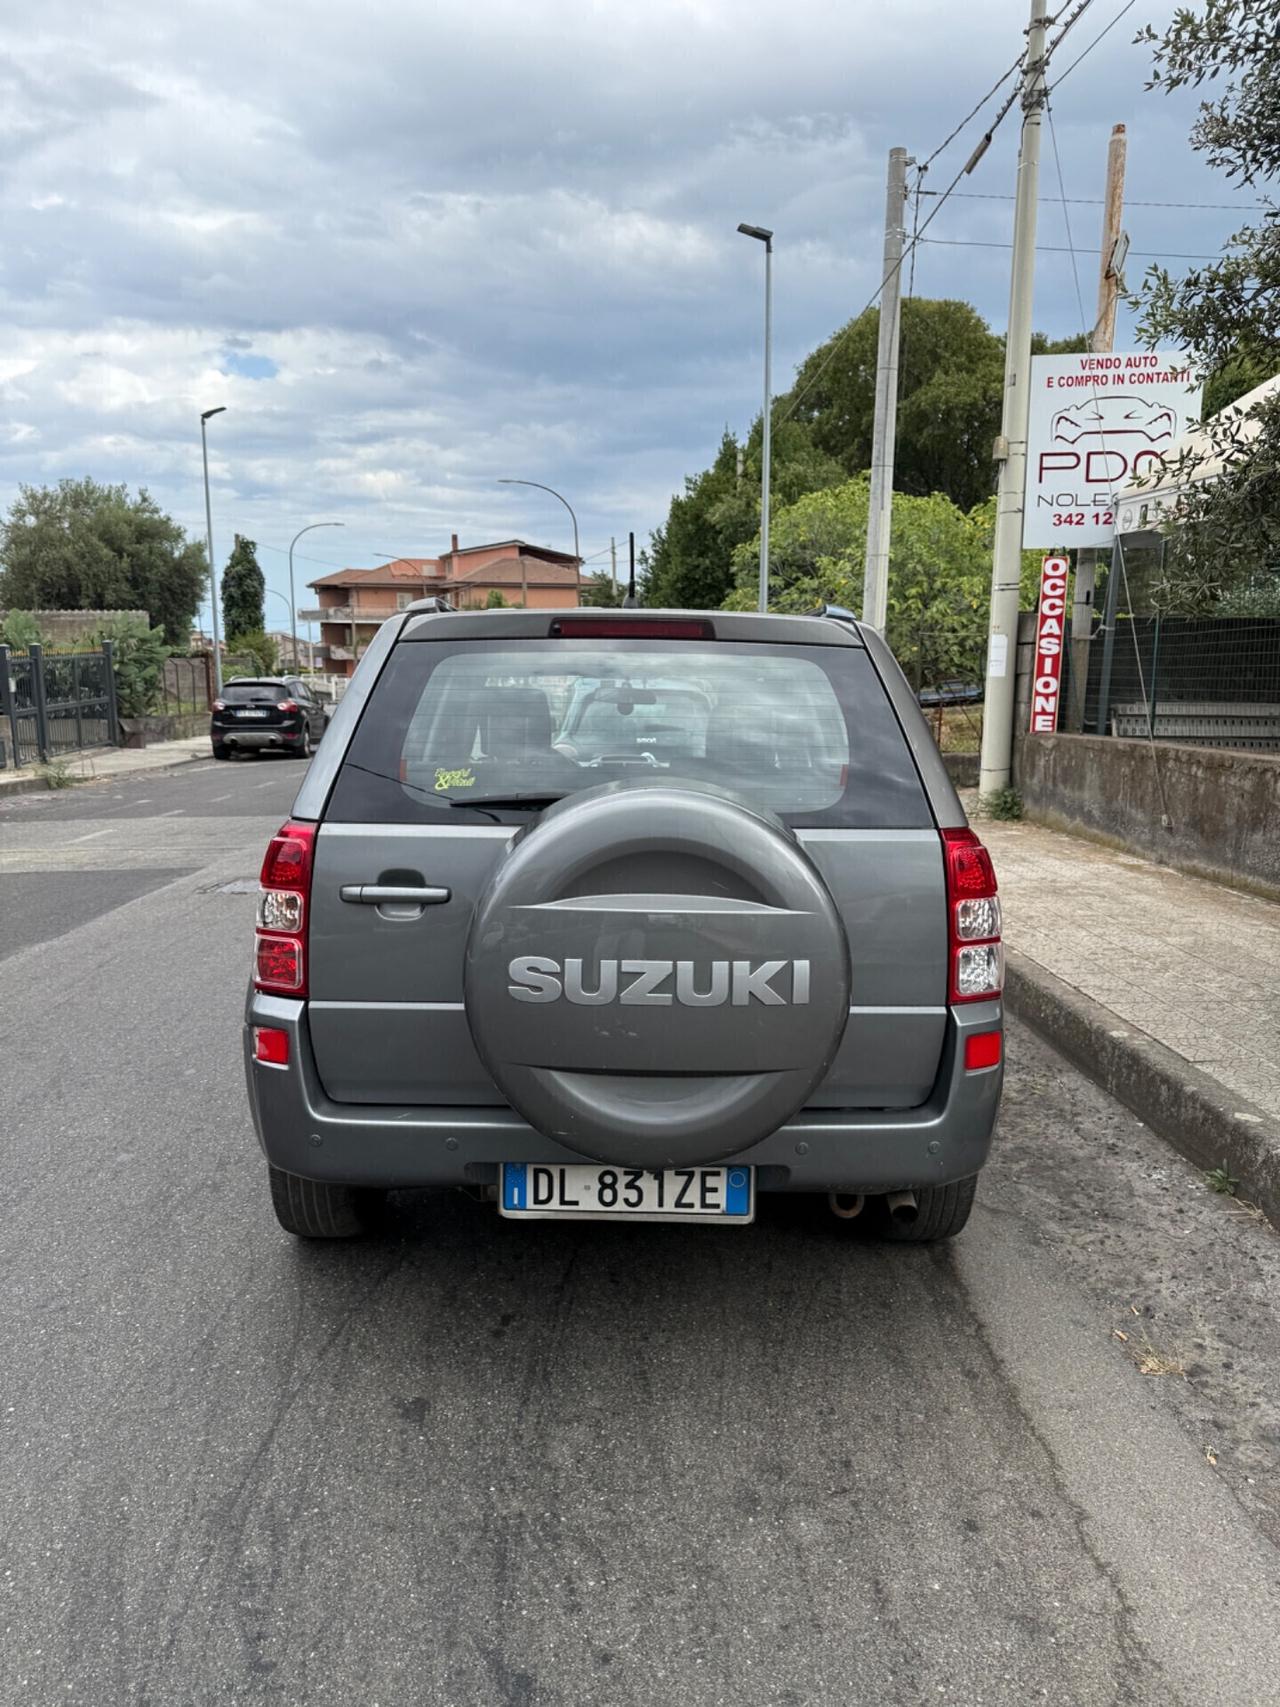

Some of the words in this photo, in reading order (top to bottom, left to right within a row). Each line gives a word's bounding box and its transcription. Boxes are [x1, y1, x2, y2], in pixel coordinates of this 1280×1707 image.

[1080, 358, 1121, 370] VENDO
[1125, 355, 1158, 369] AUTO
[1047, 376, 1054, 388] E
[1058, 374, 1108, 388] COMPRO
[1112, 373, 1125, 385] IN
[1052, 513, 1085, 527] 342
[1034, 558, 1067, 732] OCCASIONE
[508, 956, 810, 1006] SUZUKI
[533, 1168, 579, 1206] DL
[598, 1169, 721, 1209] 831ZE
